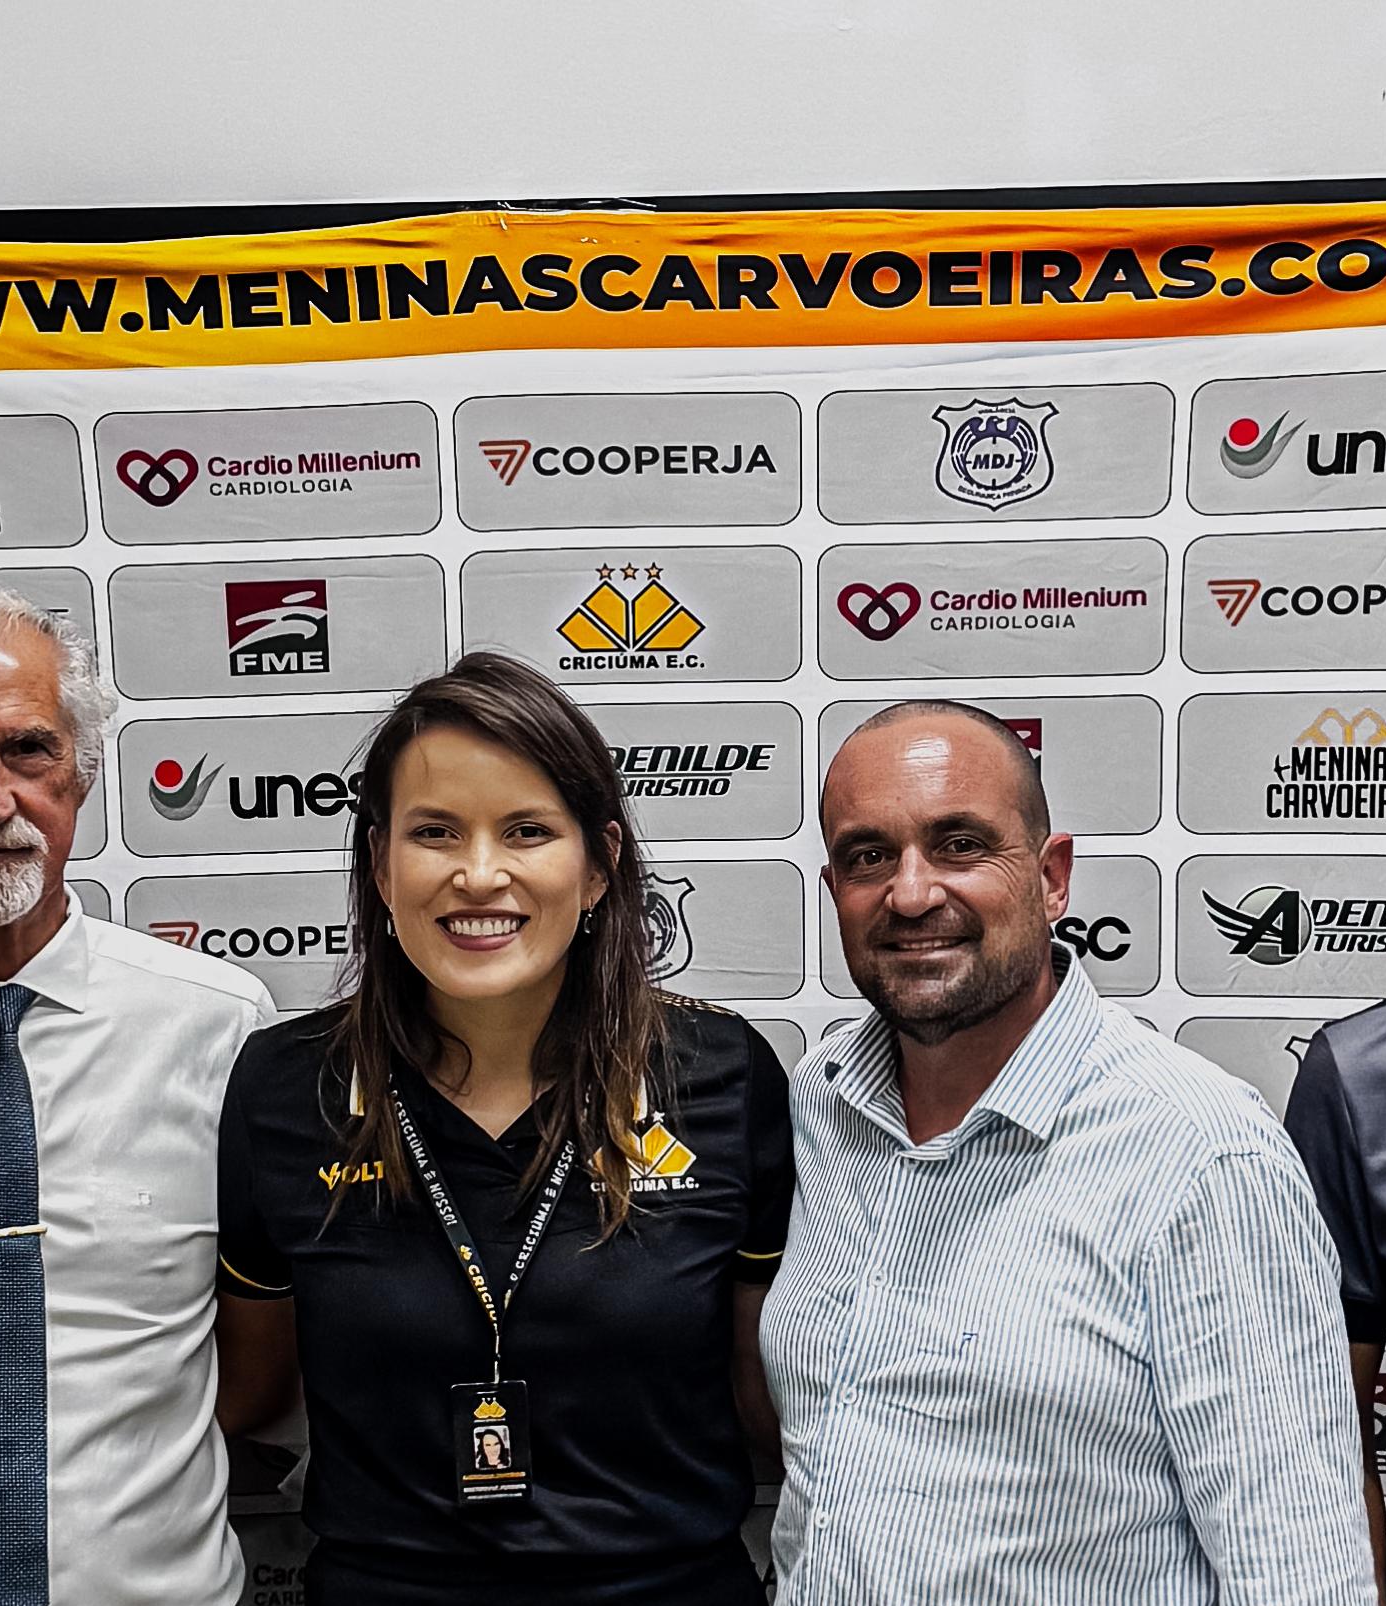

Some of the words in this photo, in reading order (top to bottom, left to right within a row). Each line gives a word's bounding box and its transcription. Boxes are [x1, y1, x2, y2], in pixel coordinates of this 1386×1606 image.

[208, 454, 292, 479] Cardio
[297, 449, 421, 475] Millenium
[532, 444, 777, 477] COOPERJA
[972, 453, 1014, 470] MDJ
[209, 478, 353, 497] CARDIOLOGIA
[930, 589, 1016, 613] Cardio
[1023, 586, 1147, 610] Millenium
[930, 614, 1076, 632] CARDIOLOGIA
[235, 652, 324, 674] FME
[559, 652, 659, 671] CRICIÚMA
[665, 654, 706, 670] E.C.
[200, 925, 349, 958] COOPE
[671, 1177, 700, 1190] E.C.
